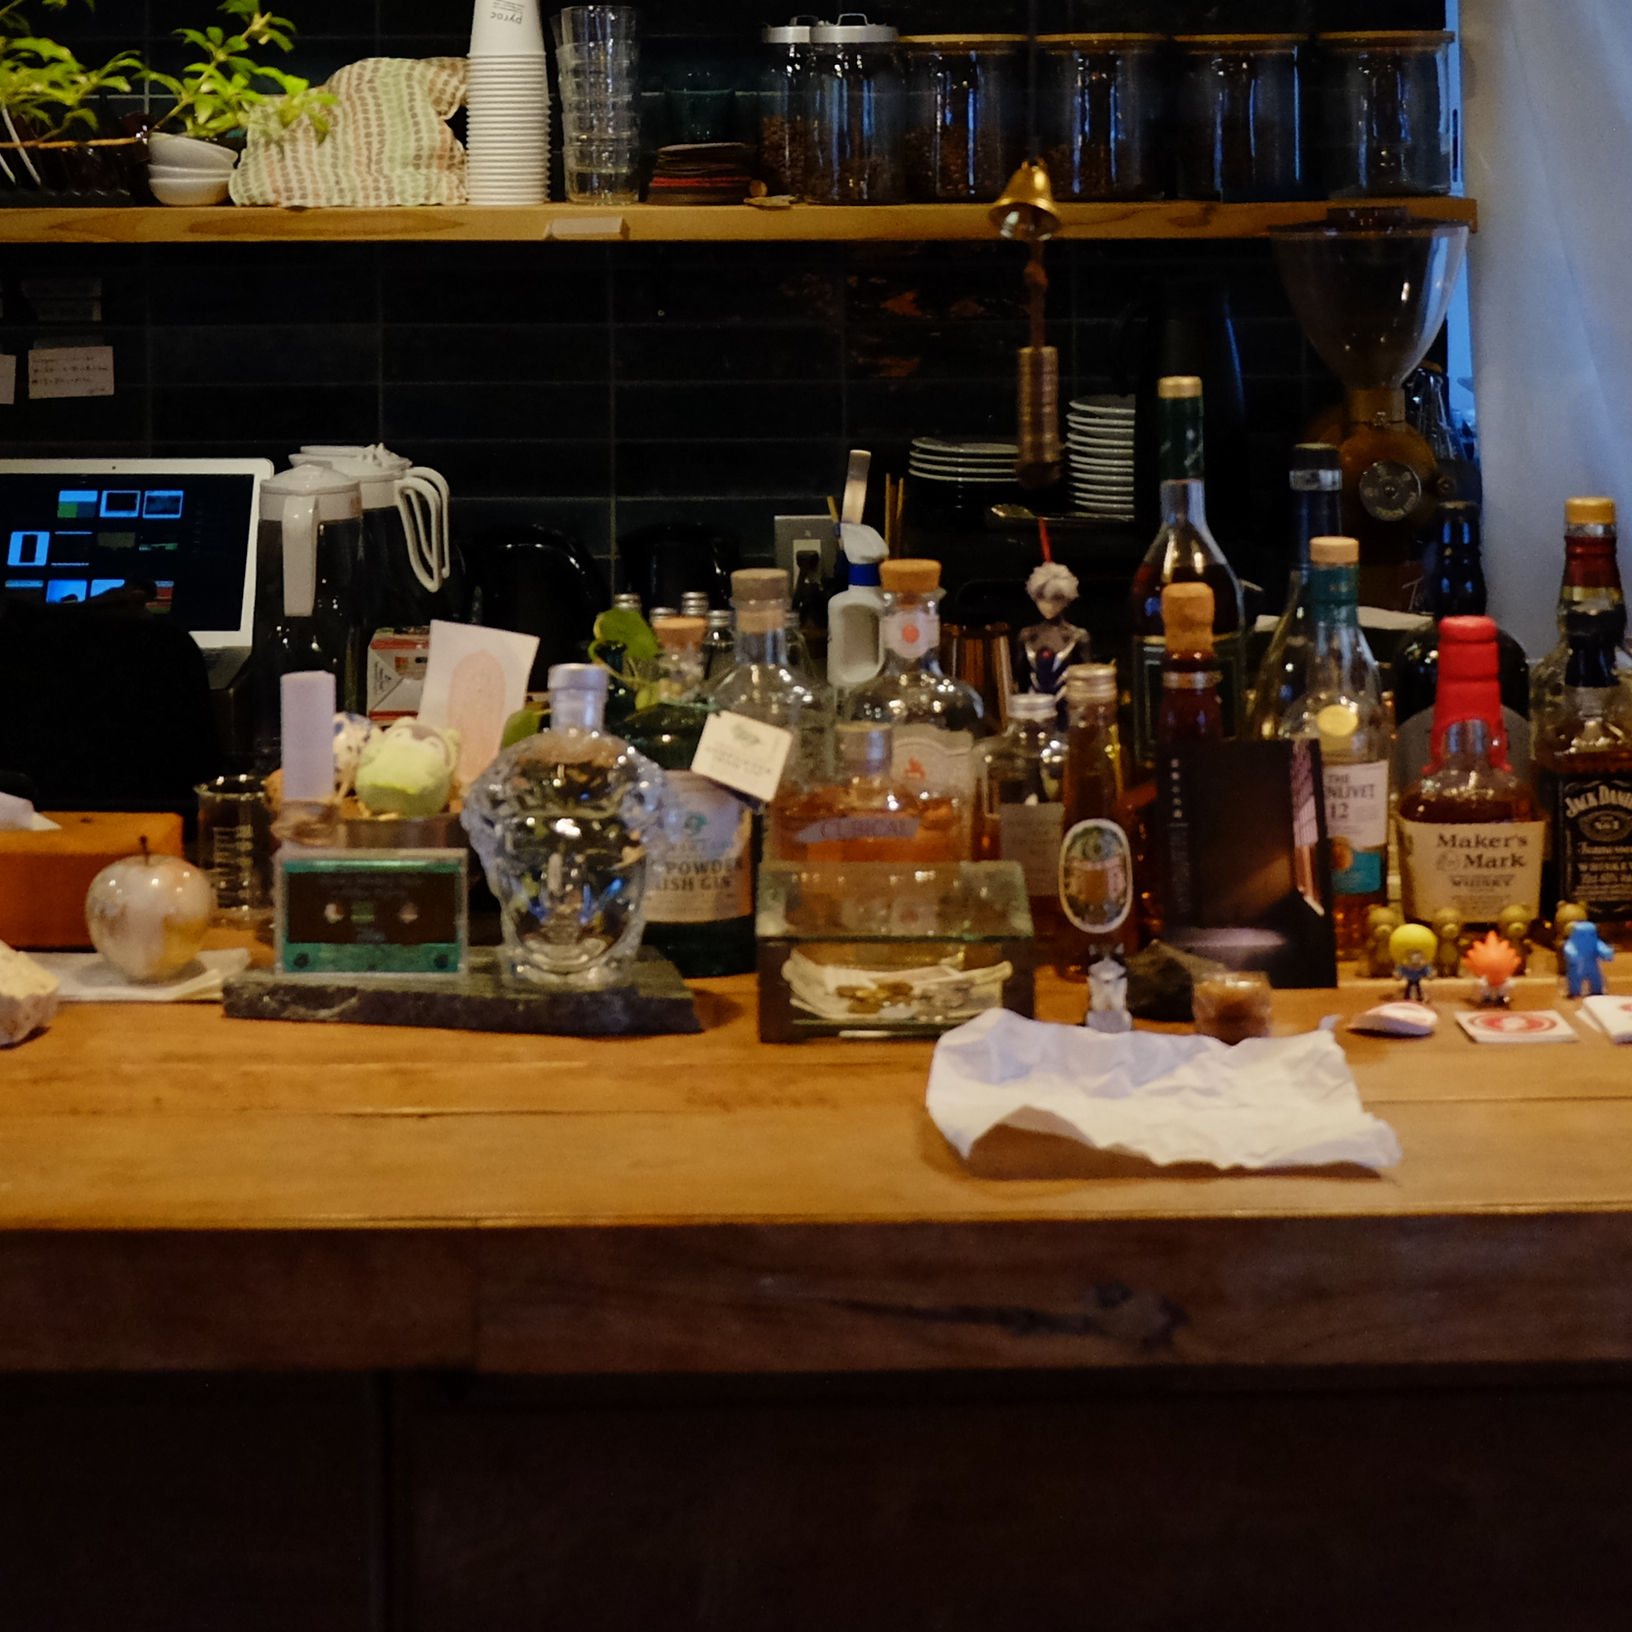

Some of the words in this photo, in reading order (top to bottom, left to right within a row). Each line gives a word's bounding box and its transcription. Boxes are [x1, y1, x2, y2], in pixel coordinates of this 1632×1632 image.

[1563, 795, 1599, 819] JACK
[1435, 833, 1529, 850] Maker's
[1463, 853, 1526, 869] Mark
